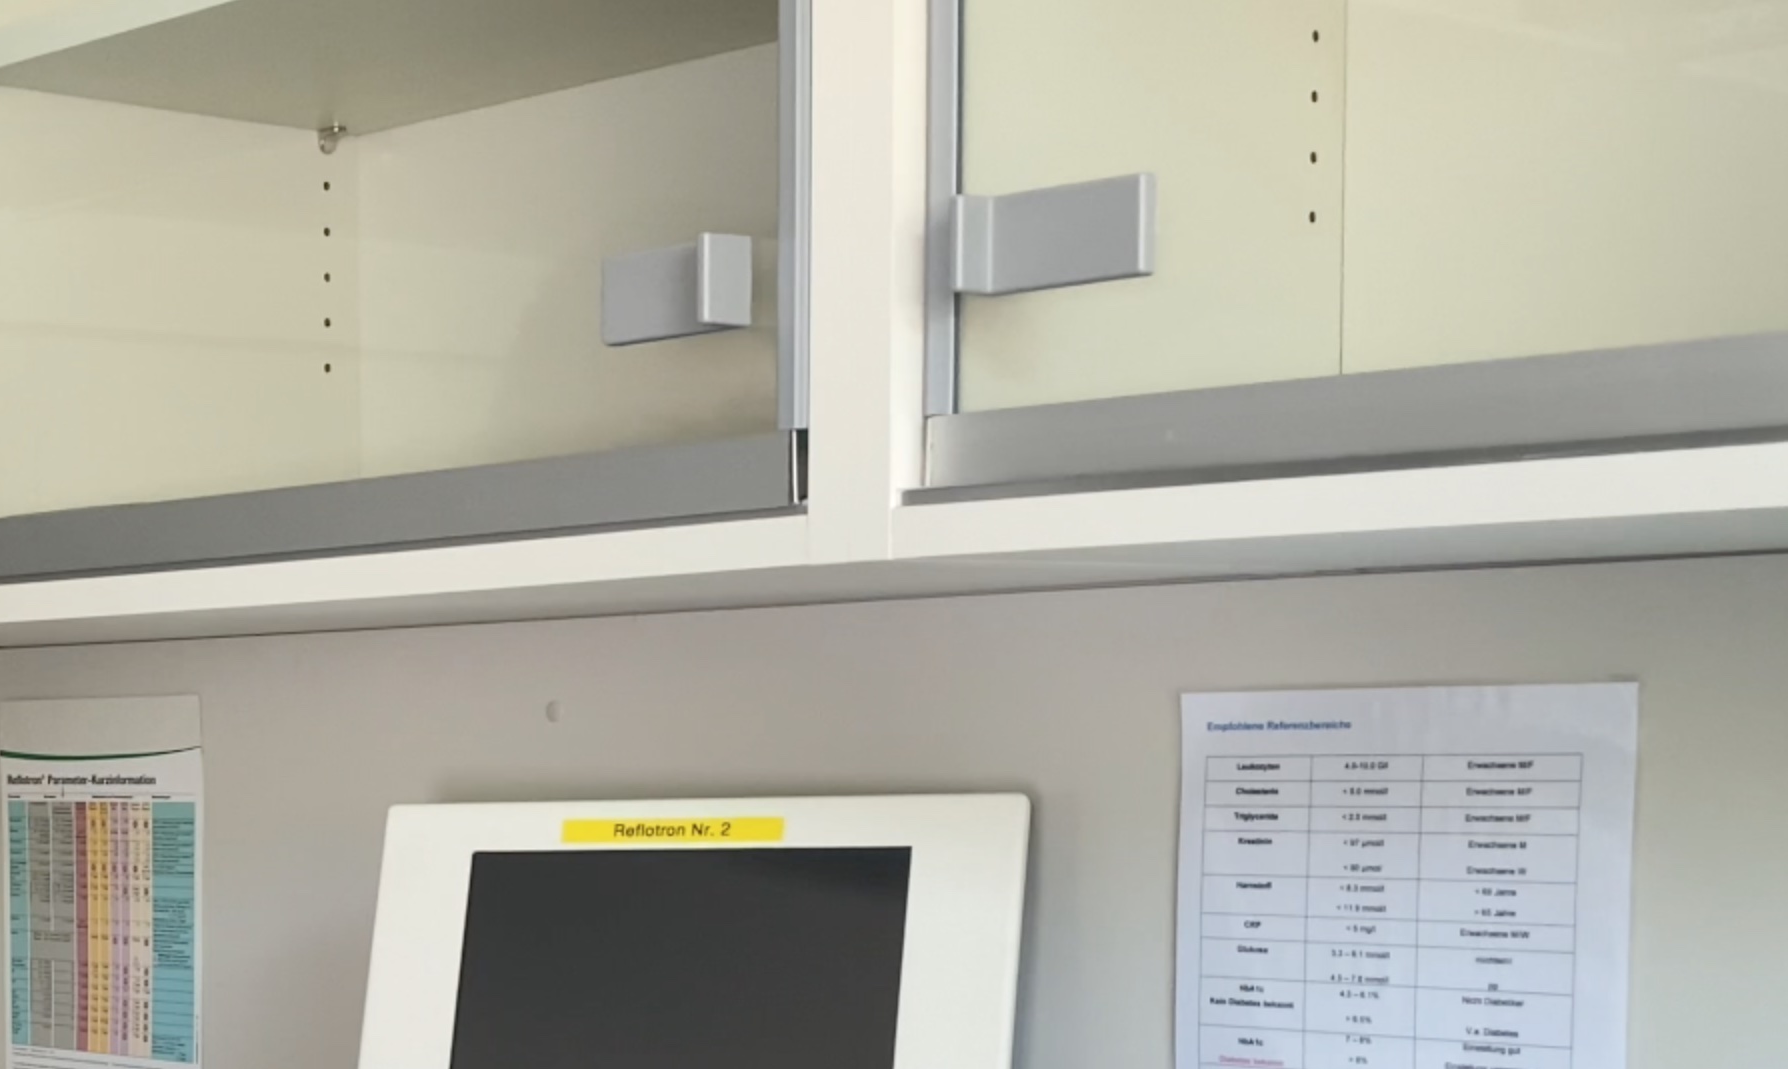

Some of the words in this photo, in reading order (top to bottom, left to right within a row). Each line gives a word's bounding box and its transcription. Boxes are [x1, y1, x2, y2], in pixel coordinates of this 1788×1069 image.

[1207, 721, 1264, 732] Empfohlene
[1267, 720, 1352, 731] Referenzbereiche
[1237, 763, 1280, 772] Leukozyten
[1467, 761, 1516, 769] Erwachsene
[1466, 788, 1514, 796] Erwachsene
[1465, 815, 1513, 823] Erwachsene
[614, 823, 686, 837] Reflotron
[691, 823, 714, 837] Nr.
[721, 822, 731, 836] 2
[1468, 840, 1517, 849] Erwachsene
[1466, 866, 1515, 875] Erwachsene
[1244, 920, 1261, 929] CRP
[1460, 928, 1508, 938] Erwachsene
[1237, 945, 1268, 954] Glukose
[1228, 998, 1261, 1007] Diabetes
[1483, 1028, 1519, 1038] Diabetes
[1508, 1047, 1521, 1056] gut
